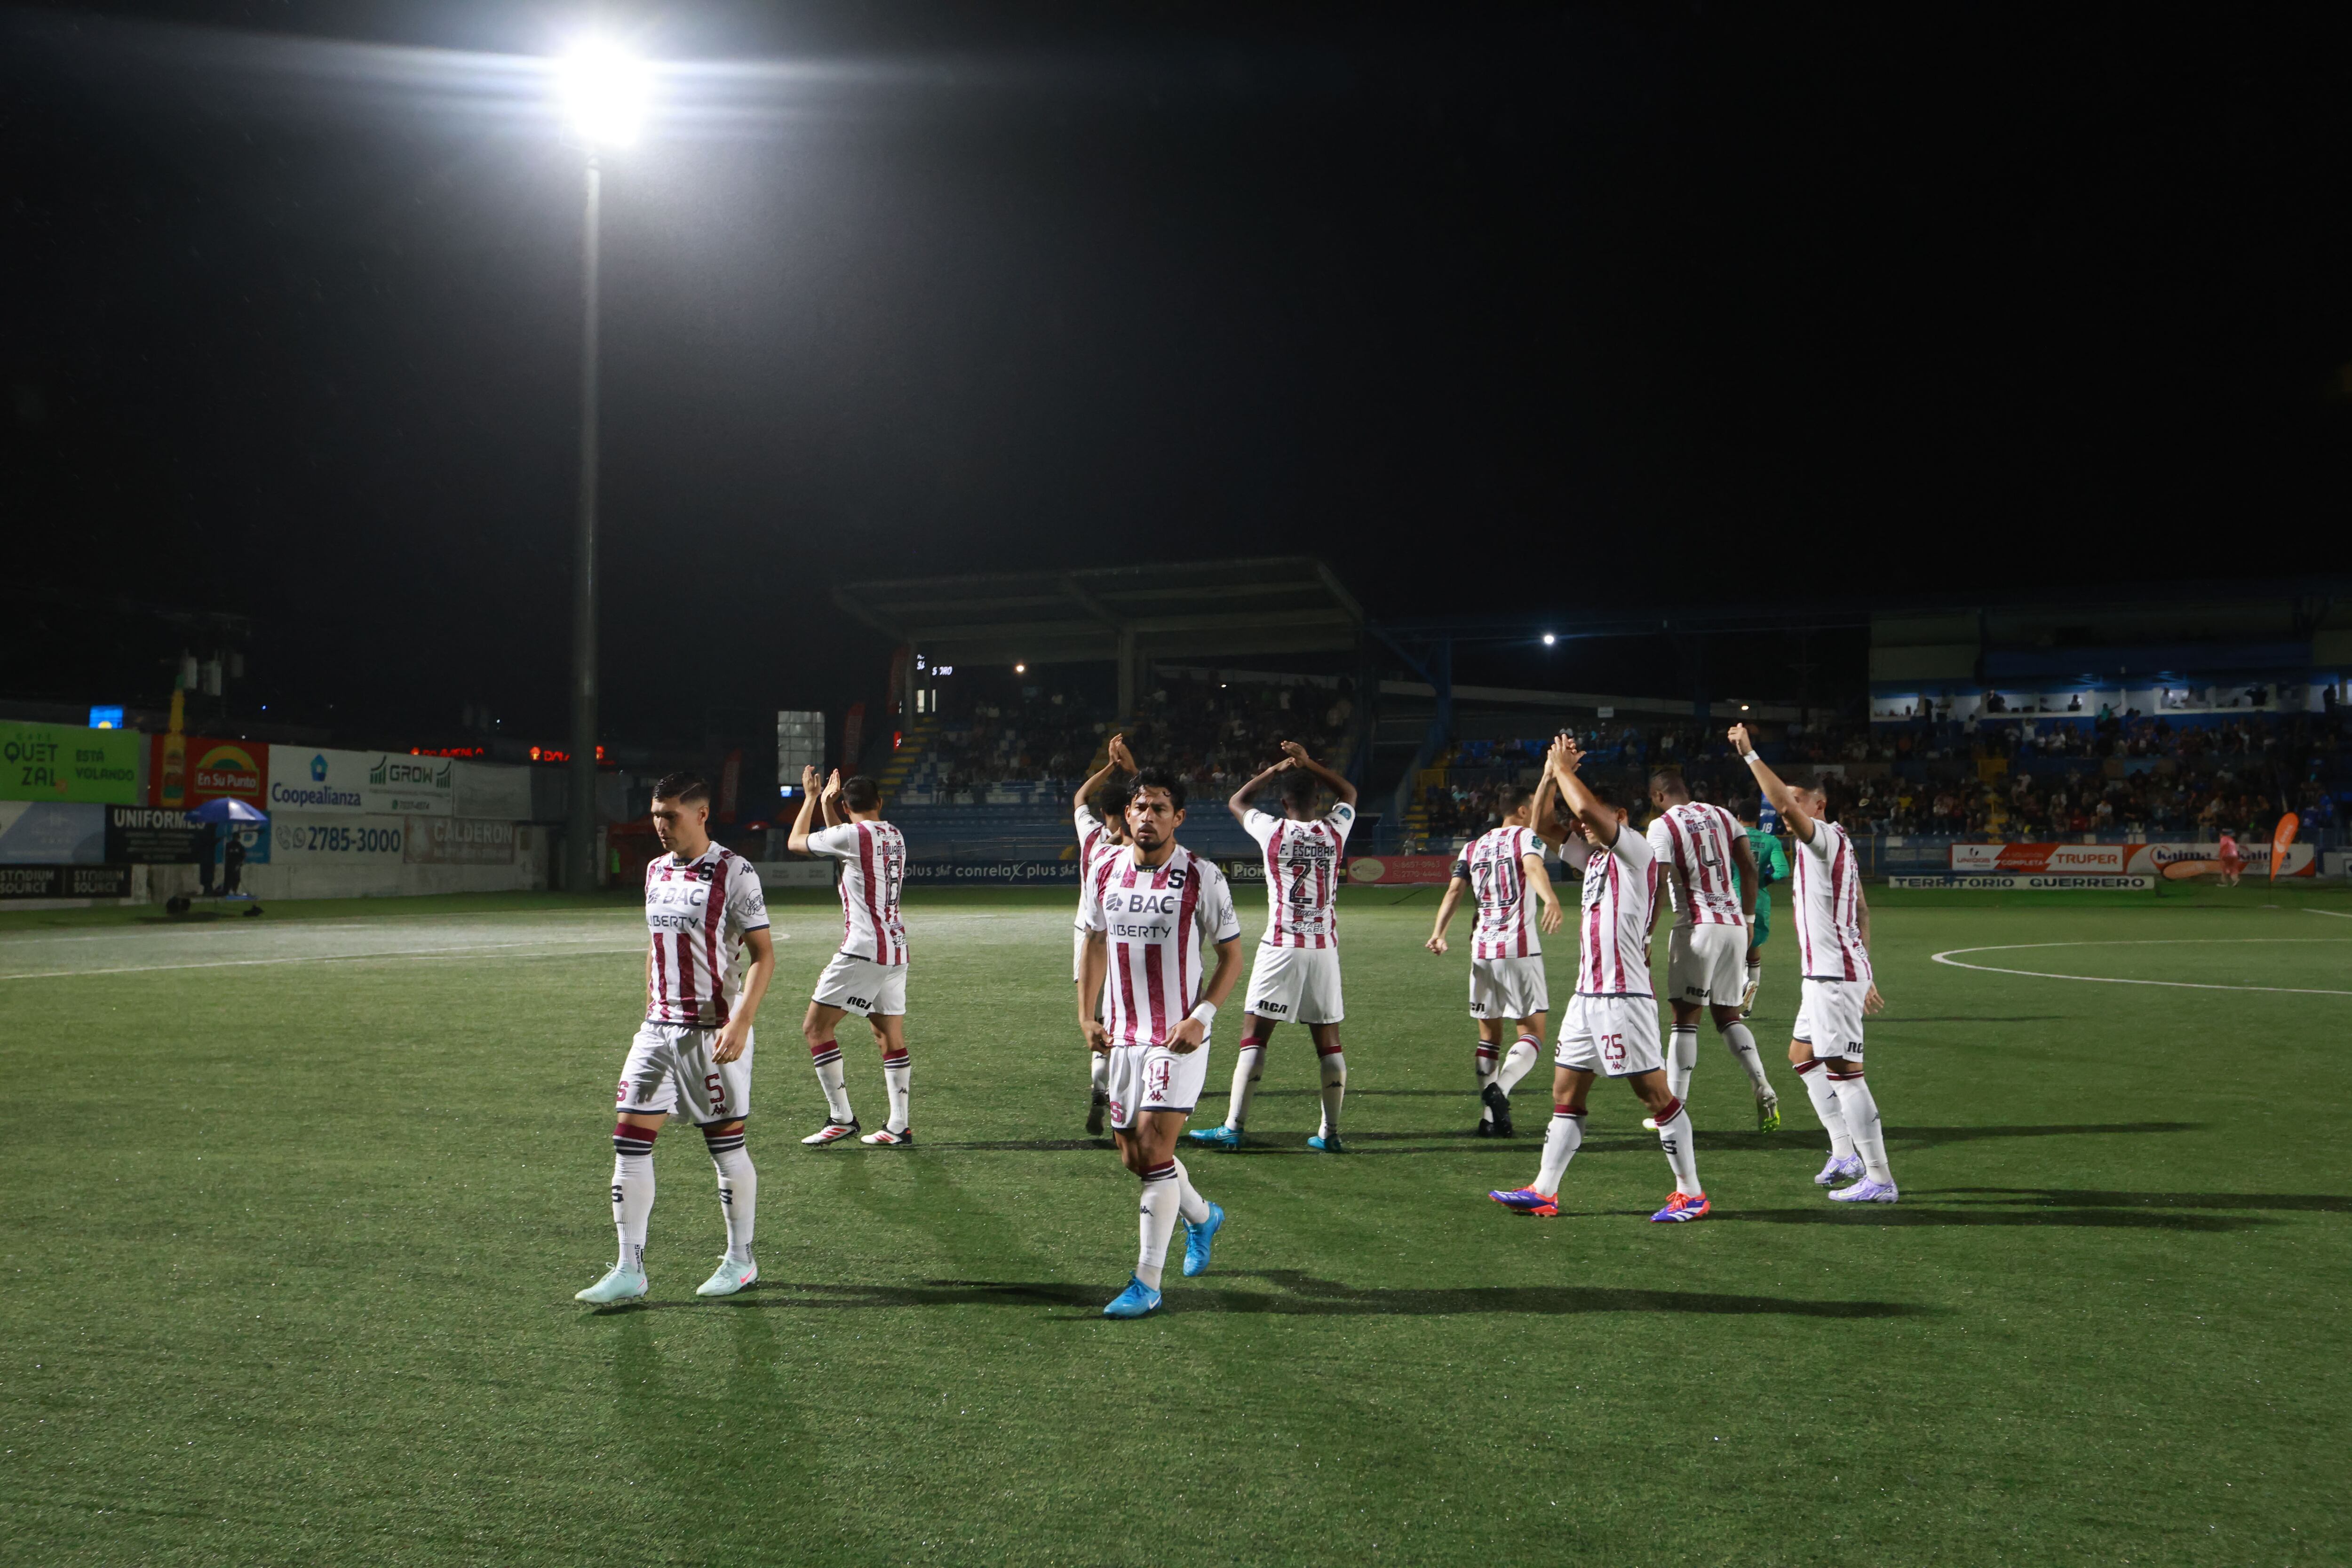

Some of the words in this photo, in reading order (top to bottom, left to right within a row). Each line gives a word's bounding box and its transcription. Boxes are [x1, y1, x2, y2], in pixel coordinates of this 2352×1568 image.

[198, 772, 211, 786] En
[213, 773, 226, 787] Su
[227, 774, 256, 788] Punto
[389, 764, 433, 783] GROW
[272, 782, 361, 807] Coopealianza
[308, 827, 401, 852] 2785-3000
[1293, 845, 1336, 857] ESCOBAR
[1699, 834, 1722, 881] 4
[2056, 854, 2118, 864] TRUPER
[1026, 864, 1057, 879] plus
[1286, 858, 1331, 904] 21
[1471, 857, 1518, 908] 20
[2029, 878, 2145, 887] GUERRERO
[663, 888, 704, 906] BAC
[1129, 894, 1175, 915] BAC
[650, 915, 699, 929] IBERTY
[1108, 923, 1172, 939] LIBERTY
[1601, 1033, 1627, 1060] 25
[1148, 1060, 1170, 1090] 14
[704, 1073, 726, 1104] 5
